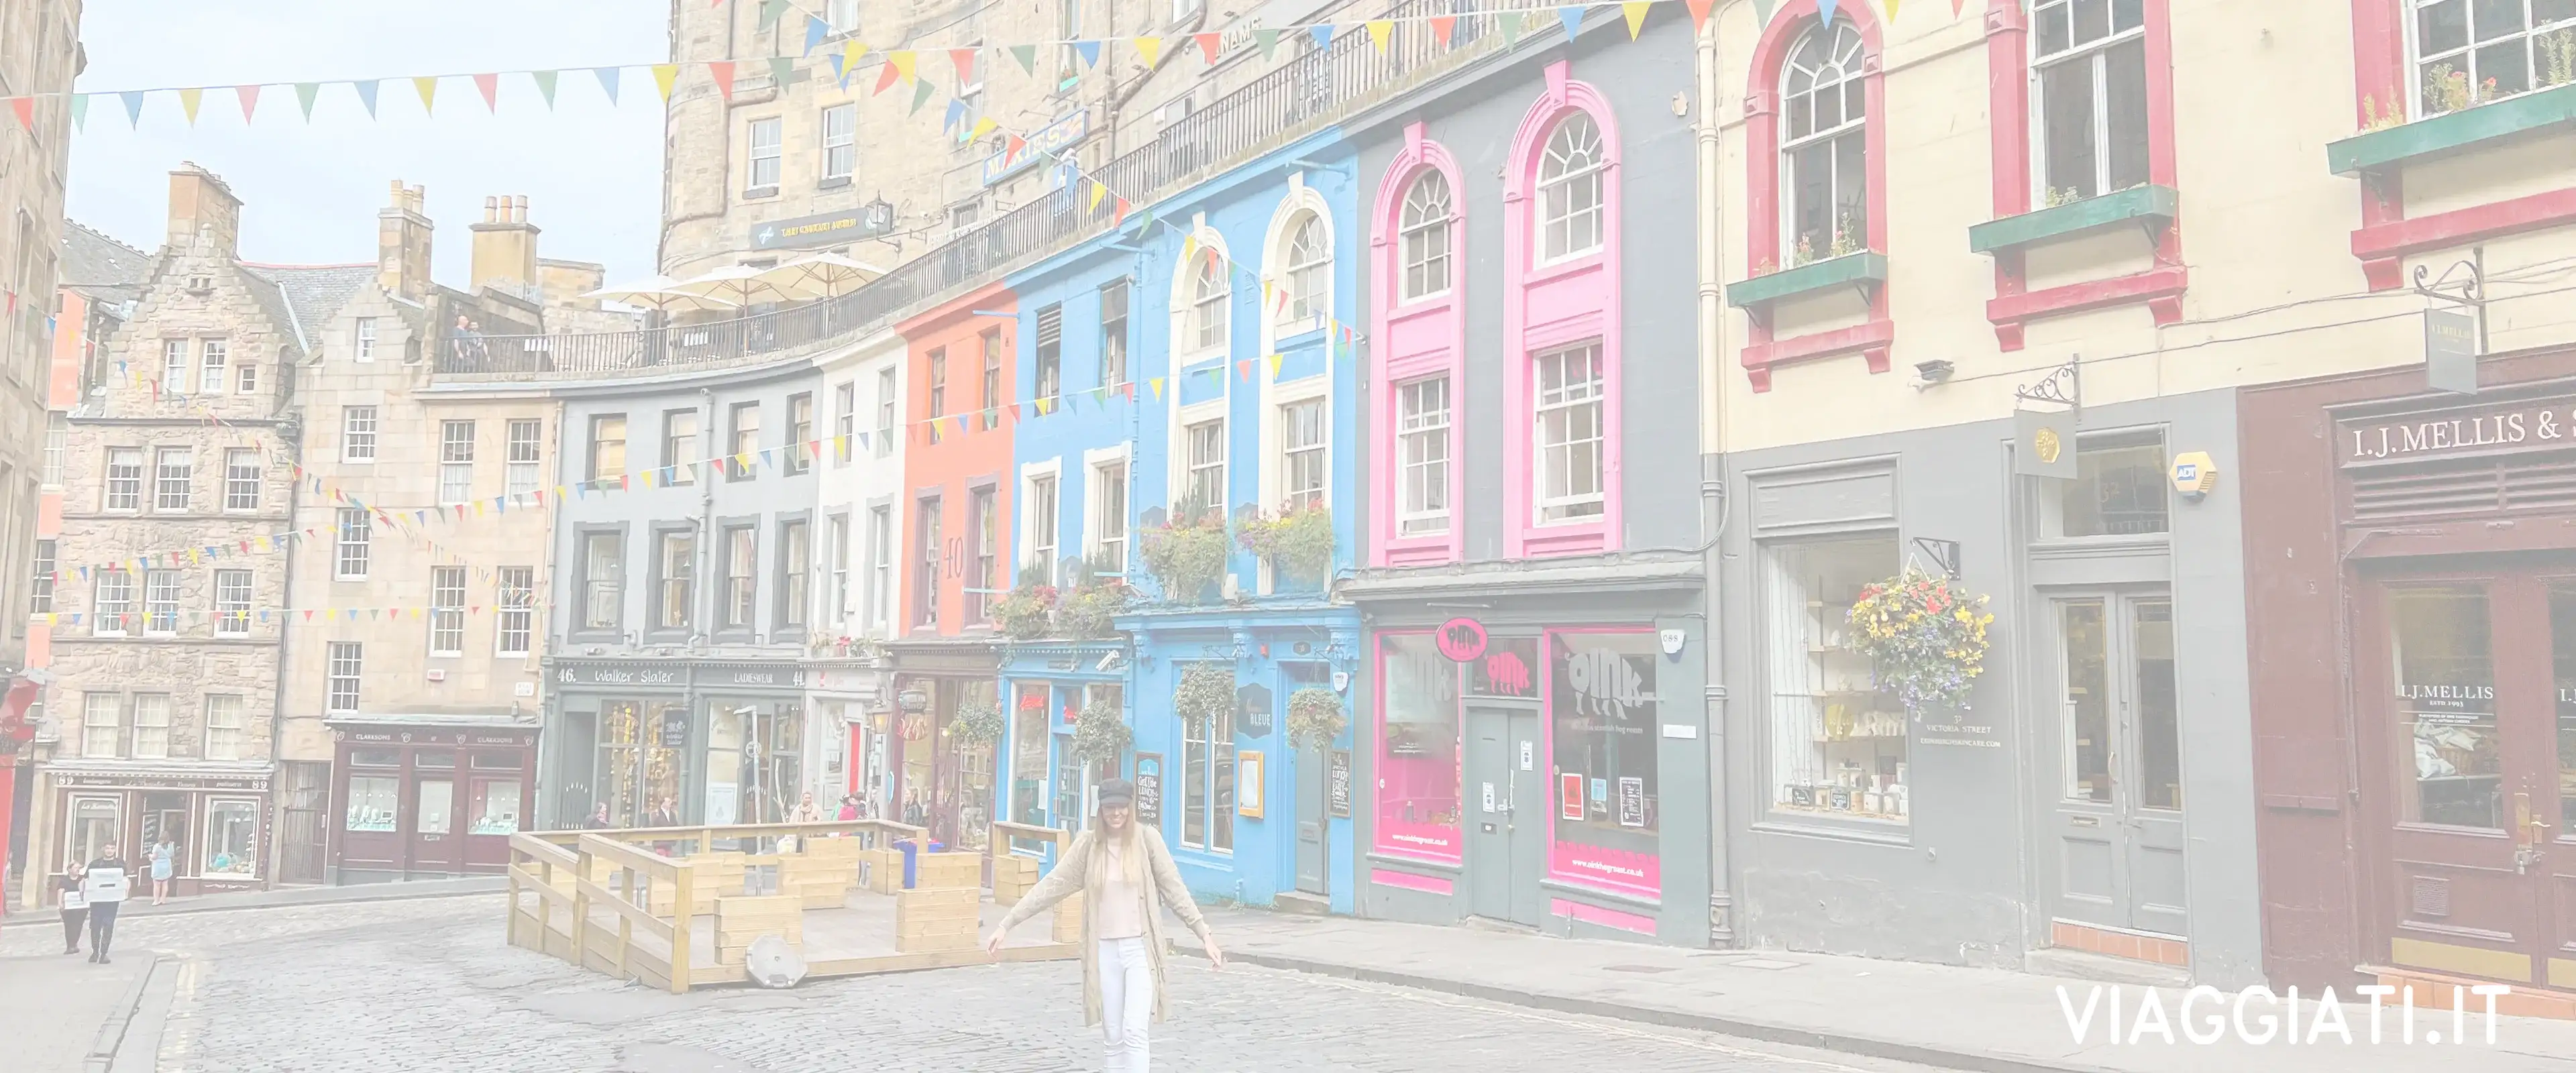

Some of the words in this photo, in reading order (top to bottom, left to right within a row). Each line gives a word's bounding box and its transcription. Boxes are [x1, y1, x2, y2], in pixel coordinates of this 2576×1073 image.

[2537, 410, 2563, 440] &
[2178, 467, 2196, 478] ADT
[944, 536, 963, 579] 40
[595, 671, 634, 683] Walker
[641, 669, 674, 683] Slater
[735, 673, 773, 684] LADIESWEAR
[1927, 724, 1959, 732] VICTORIA
[1962, 726, 1992, 734] STREET
[58, 775, 74, 785] 89
[252, 780, 268, 789] 89
